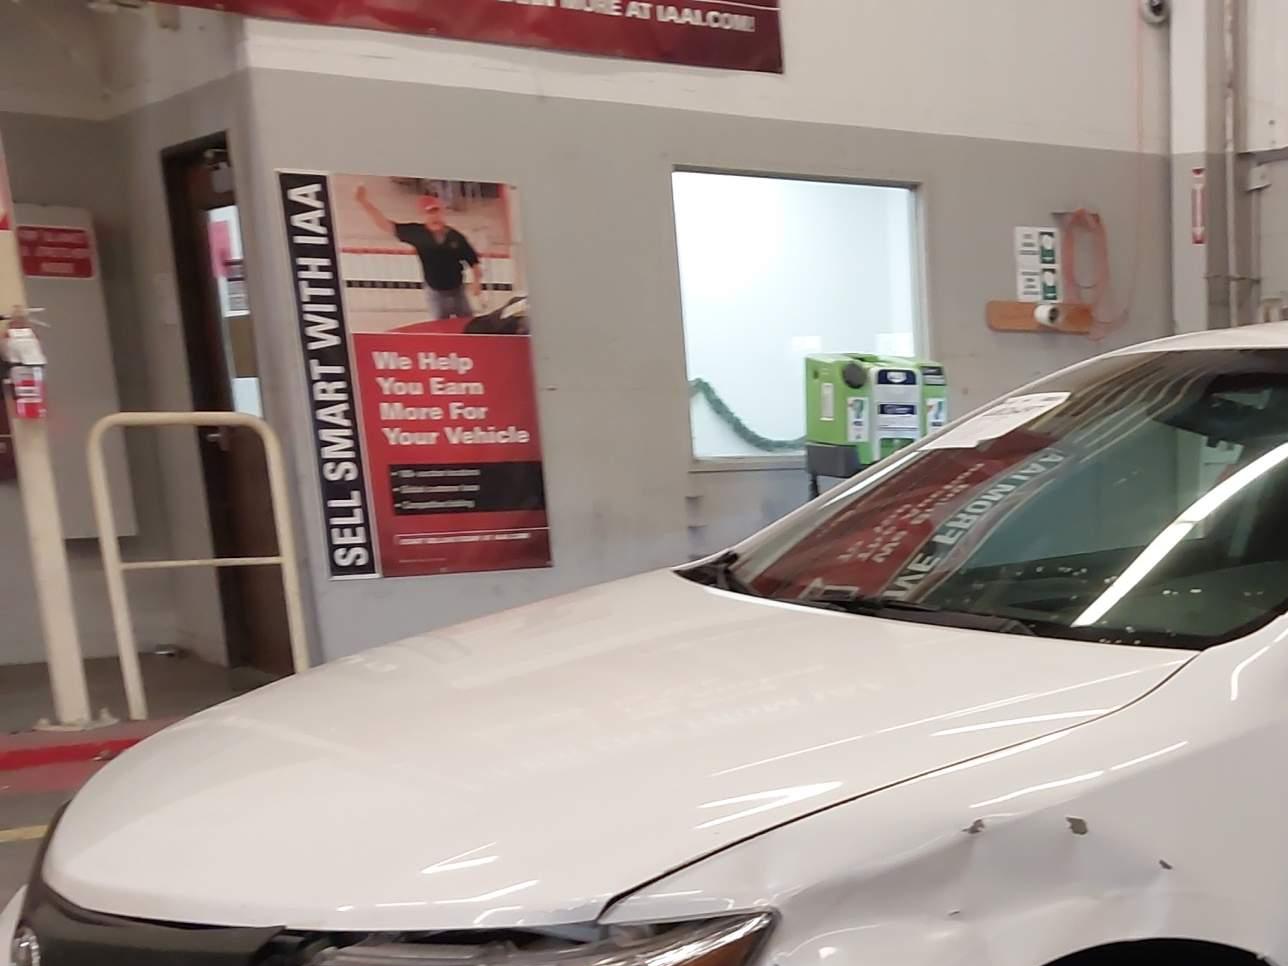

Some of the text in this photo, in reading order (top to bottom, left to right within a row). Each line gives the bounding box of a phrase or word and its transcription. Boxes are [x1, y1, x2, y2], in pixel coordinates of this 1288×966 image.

[626, 2, 652, 19] AT
[372, 351, 473, 374] We Help
[287, 183, 369, 566] SELL SMART WITH IAA
[375, 377, 484, 395] You Earn
[379, 402, 488, 420] More For
[381, 426, 530, 445] Your Vehicle
